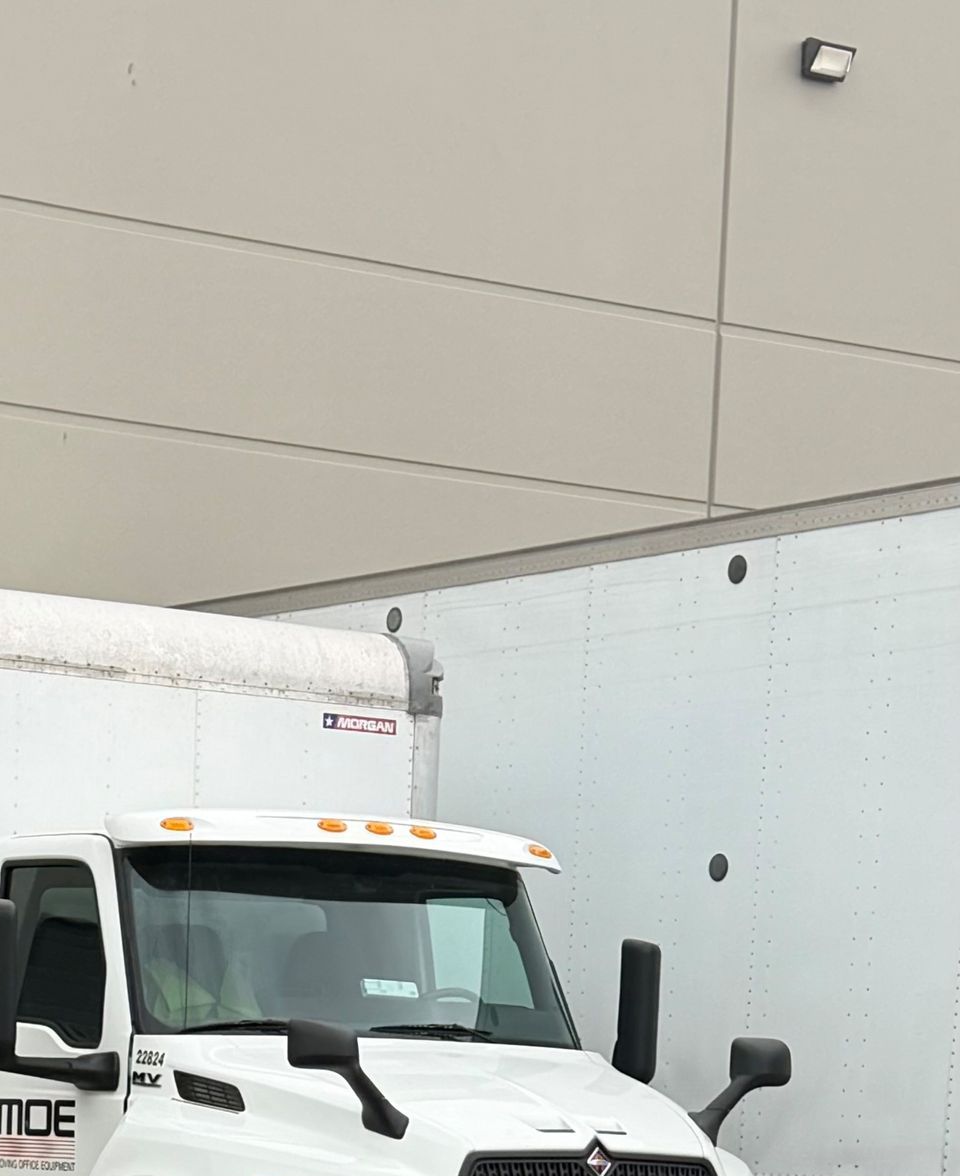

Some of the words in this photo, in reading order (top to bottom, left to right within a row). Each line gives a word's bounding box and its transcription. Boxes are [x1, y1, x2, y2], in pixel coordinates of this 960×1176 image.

[337, 717, 394, 733] MORGAN
[136, 1049, 165, 1066] 22824
[132, 1071, 162, 1084] MV
[18, 1159, 39, 1170] OFFICE
[41, 1160, 75, 1172] EQUIPMENT
